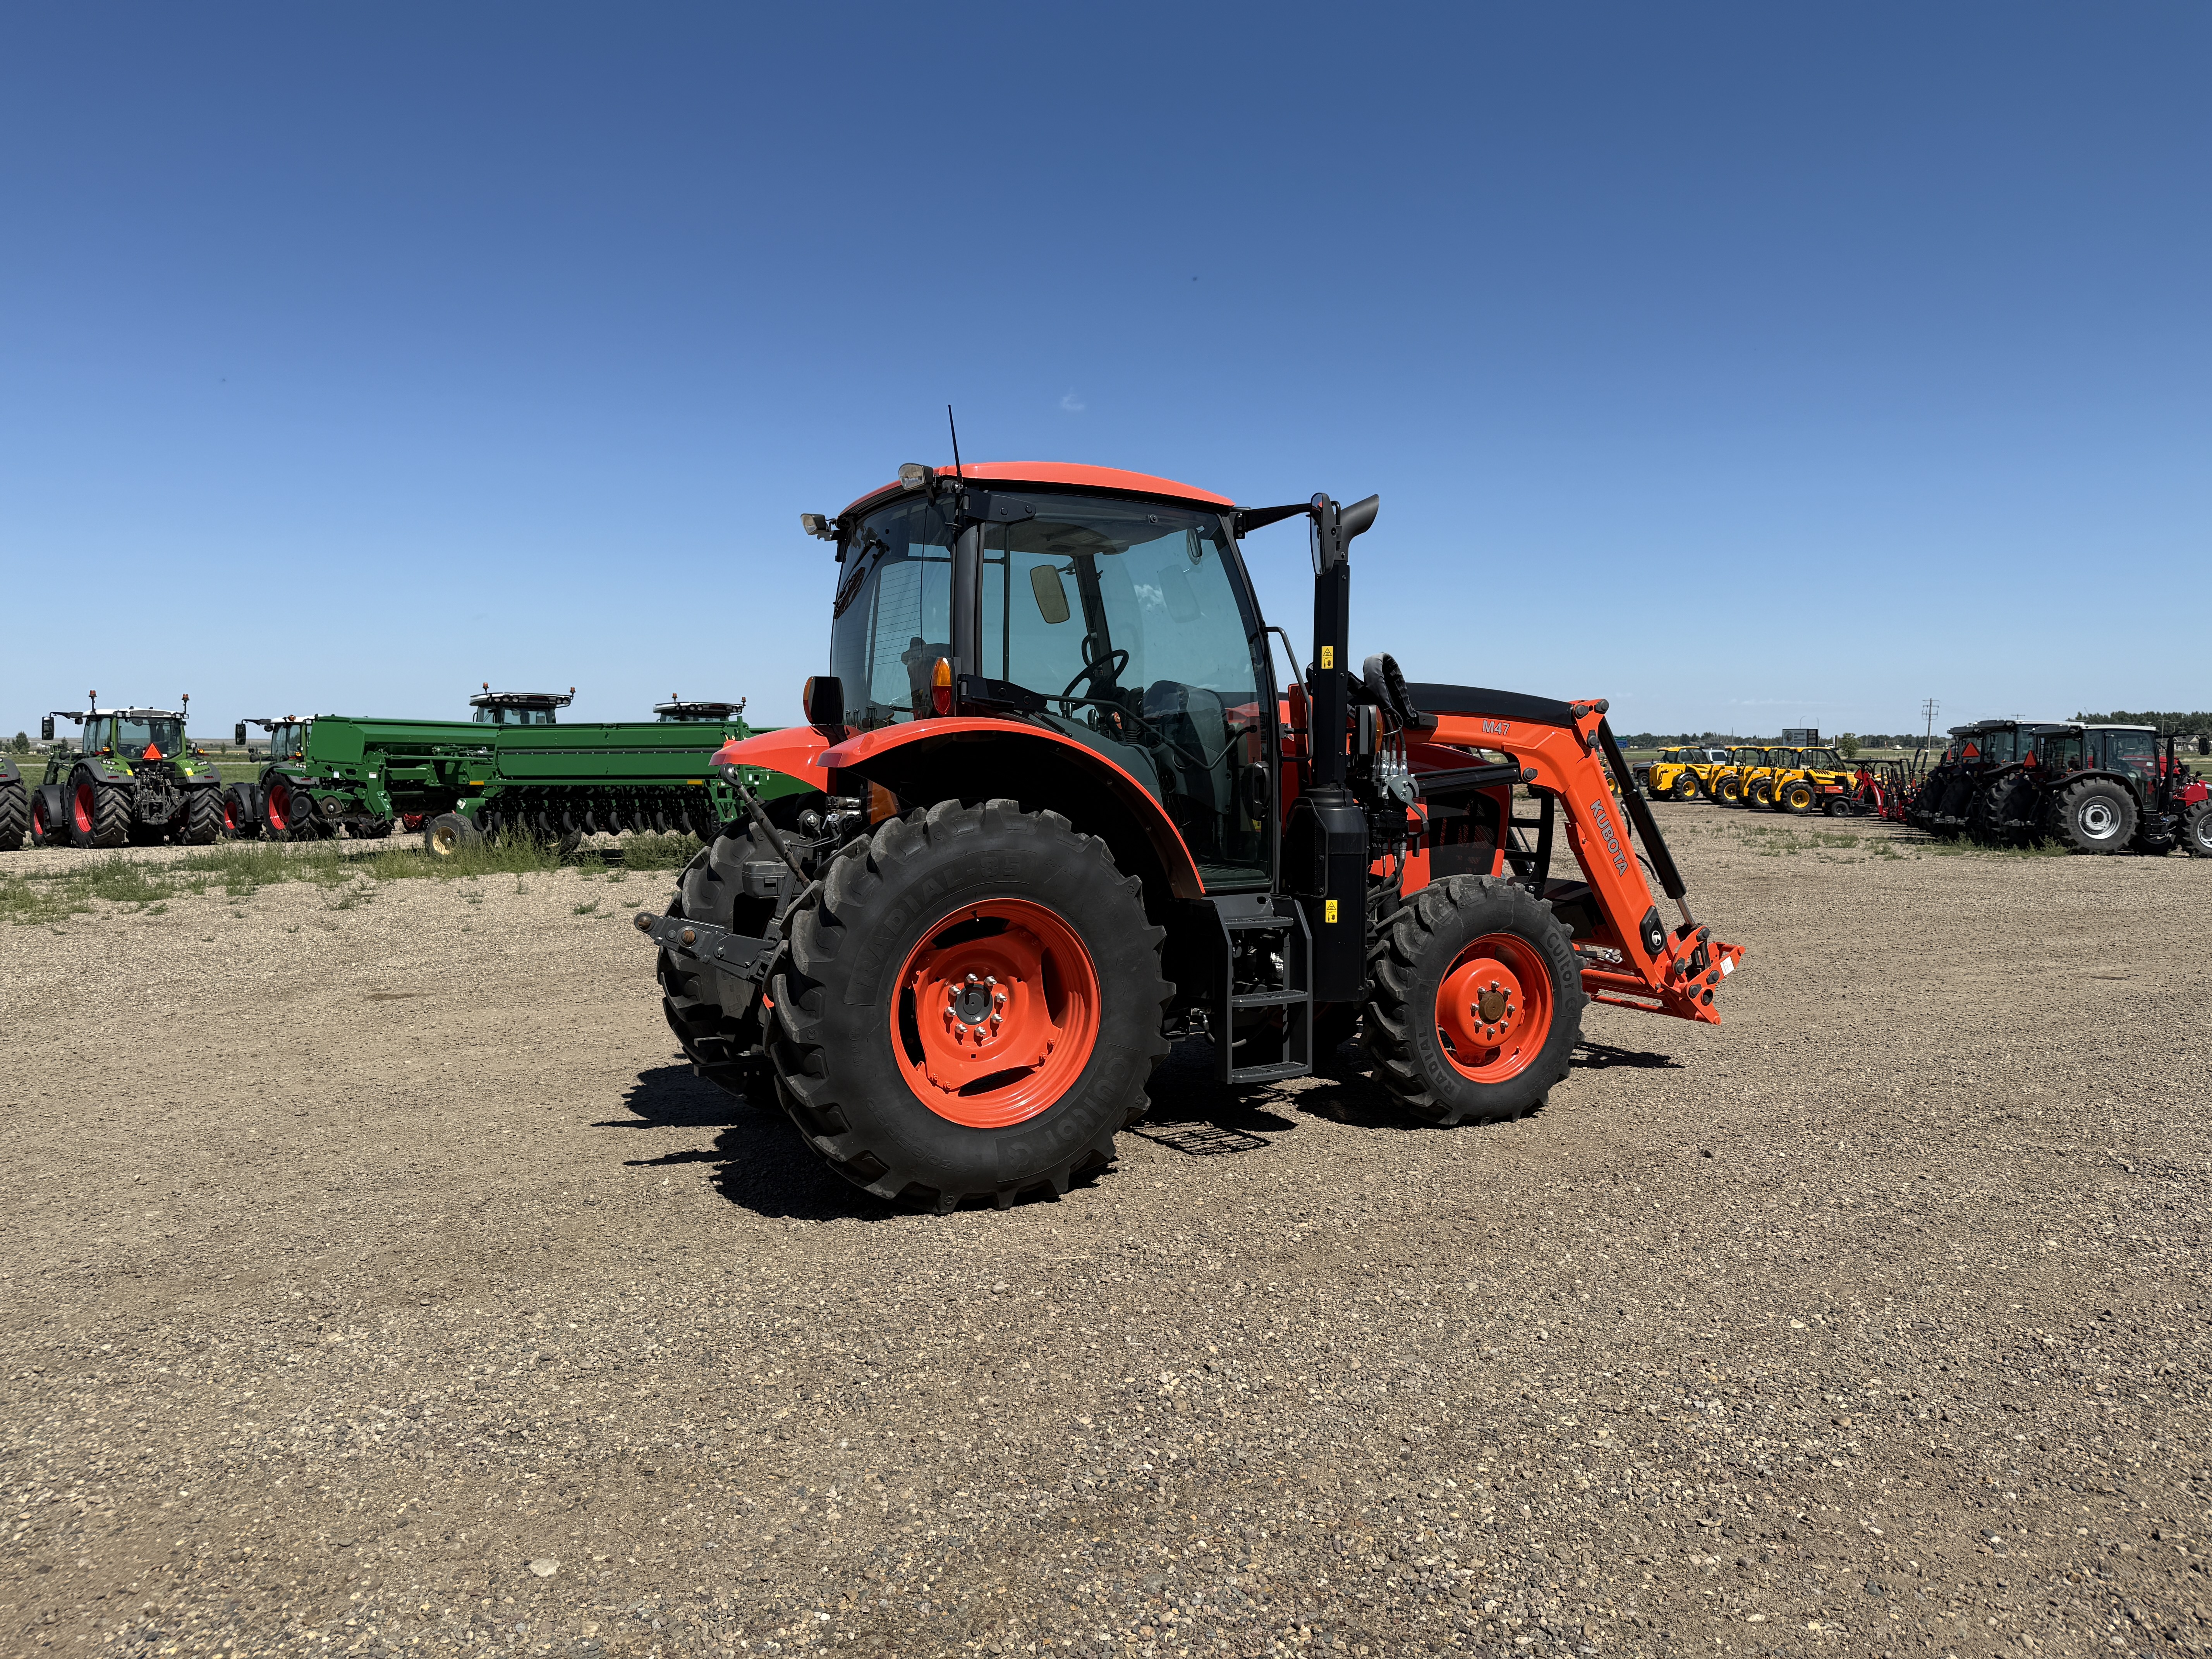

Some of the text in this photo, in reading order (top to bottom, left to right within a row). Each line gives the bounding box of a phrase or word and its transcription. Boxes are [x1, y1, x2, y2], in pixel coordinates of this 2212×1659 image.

[1482, 720, 1510, 735] M47
[1590, 799, 1628, 876] KUBOTA
[855, 856, 1022, 989] RADIAL-85
[1546, 932, 1575, 993] Cultor
[1044, 1057, 1128, 1154] Cultor
